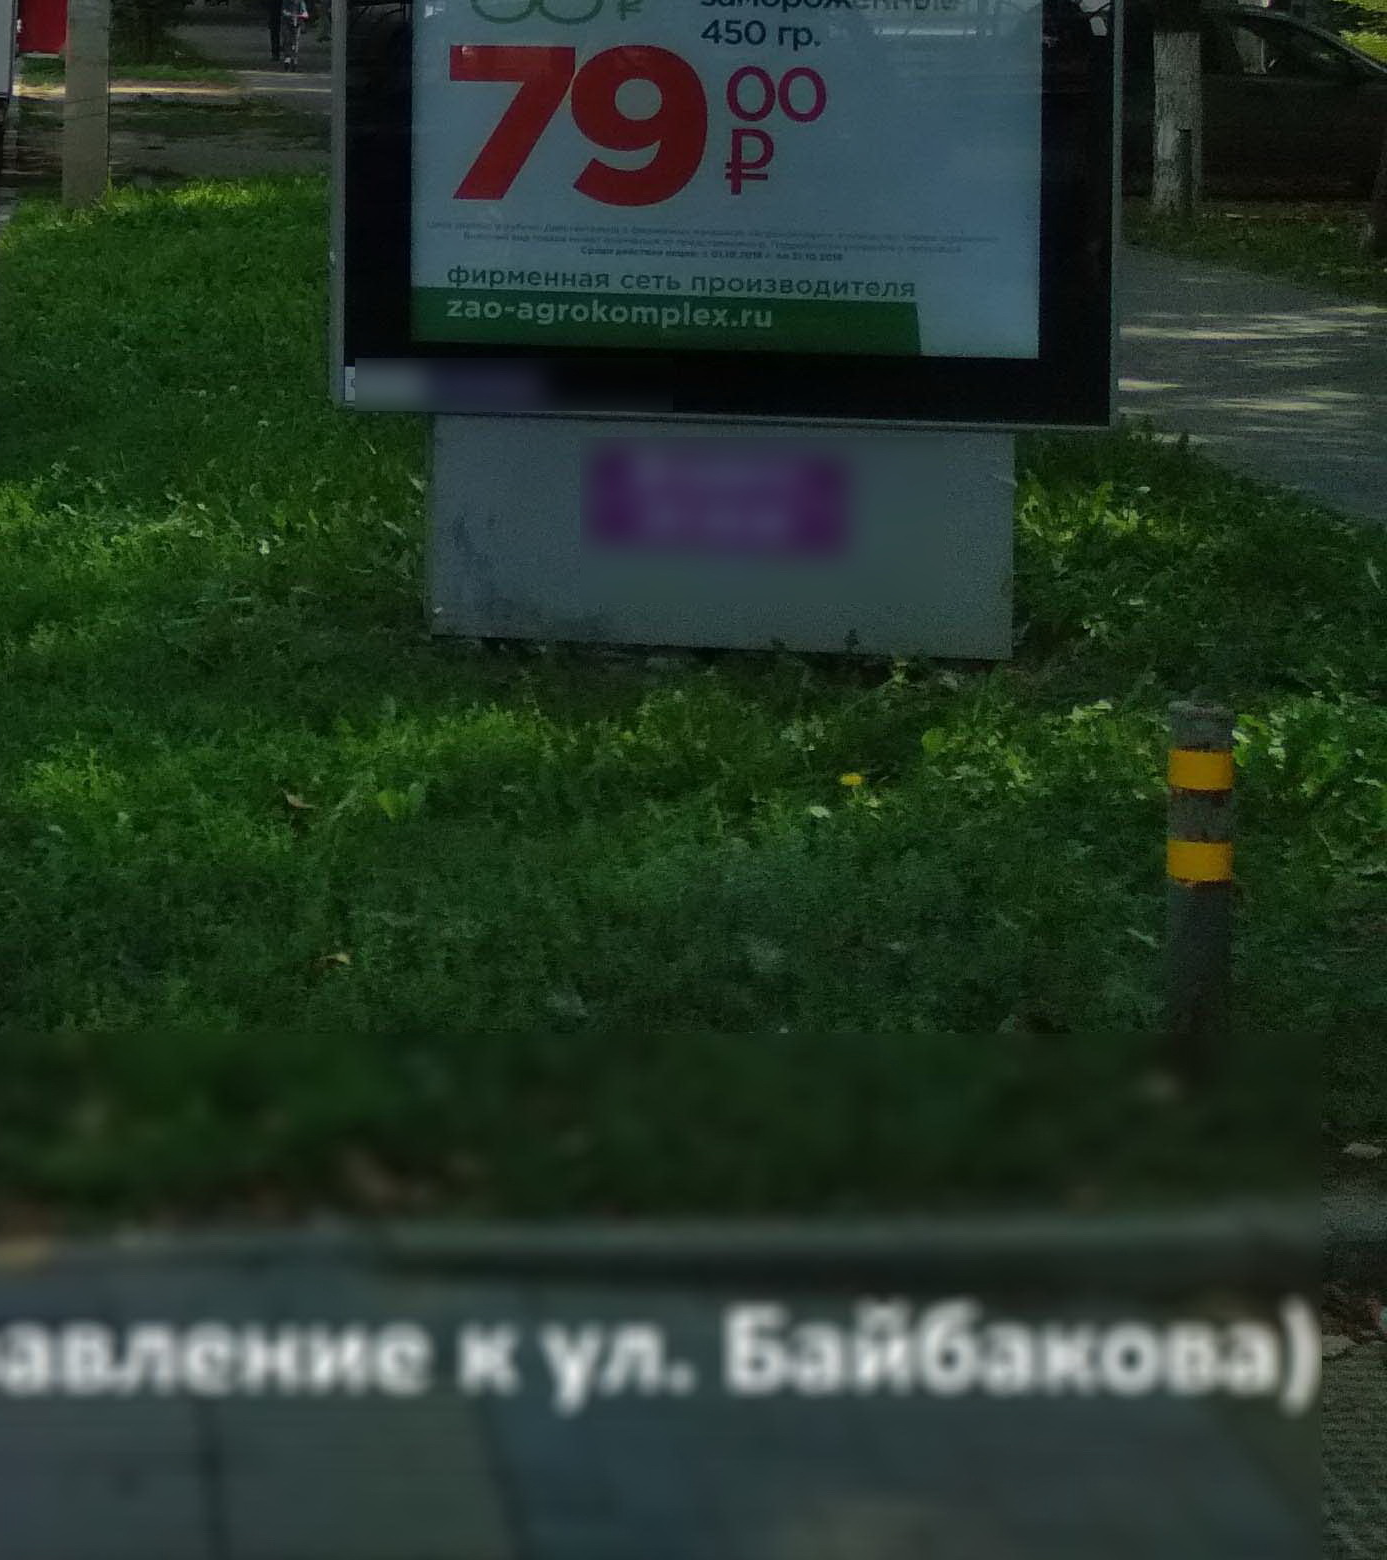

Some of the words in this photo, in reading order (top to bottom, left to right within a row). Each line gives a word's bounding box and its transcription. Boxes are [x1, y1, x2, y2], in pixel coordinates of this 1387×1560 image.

[700, 19, 767, 46] 450
[778, 26, 821, 51] гр.
[727, 65, 827, 123] 00
[449, 44, 708, 207] 79
[446, 265, 611, 289] фирменная
[620, 272, 682, 290] сеть
[691, 275, 916, 298] производителя
[445, 298, 773, 329] zao-agrokomplex.ru
